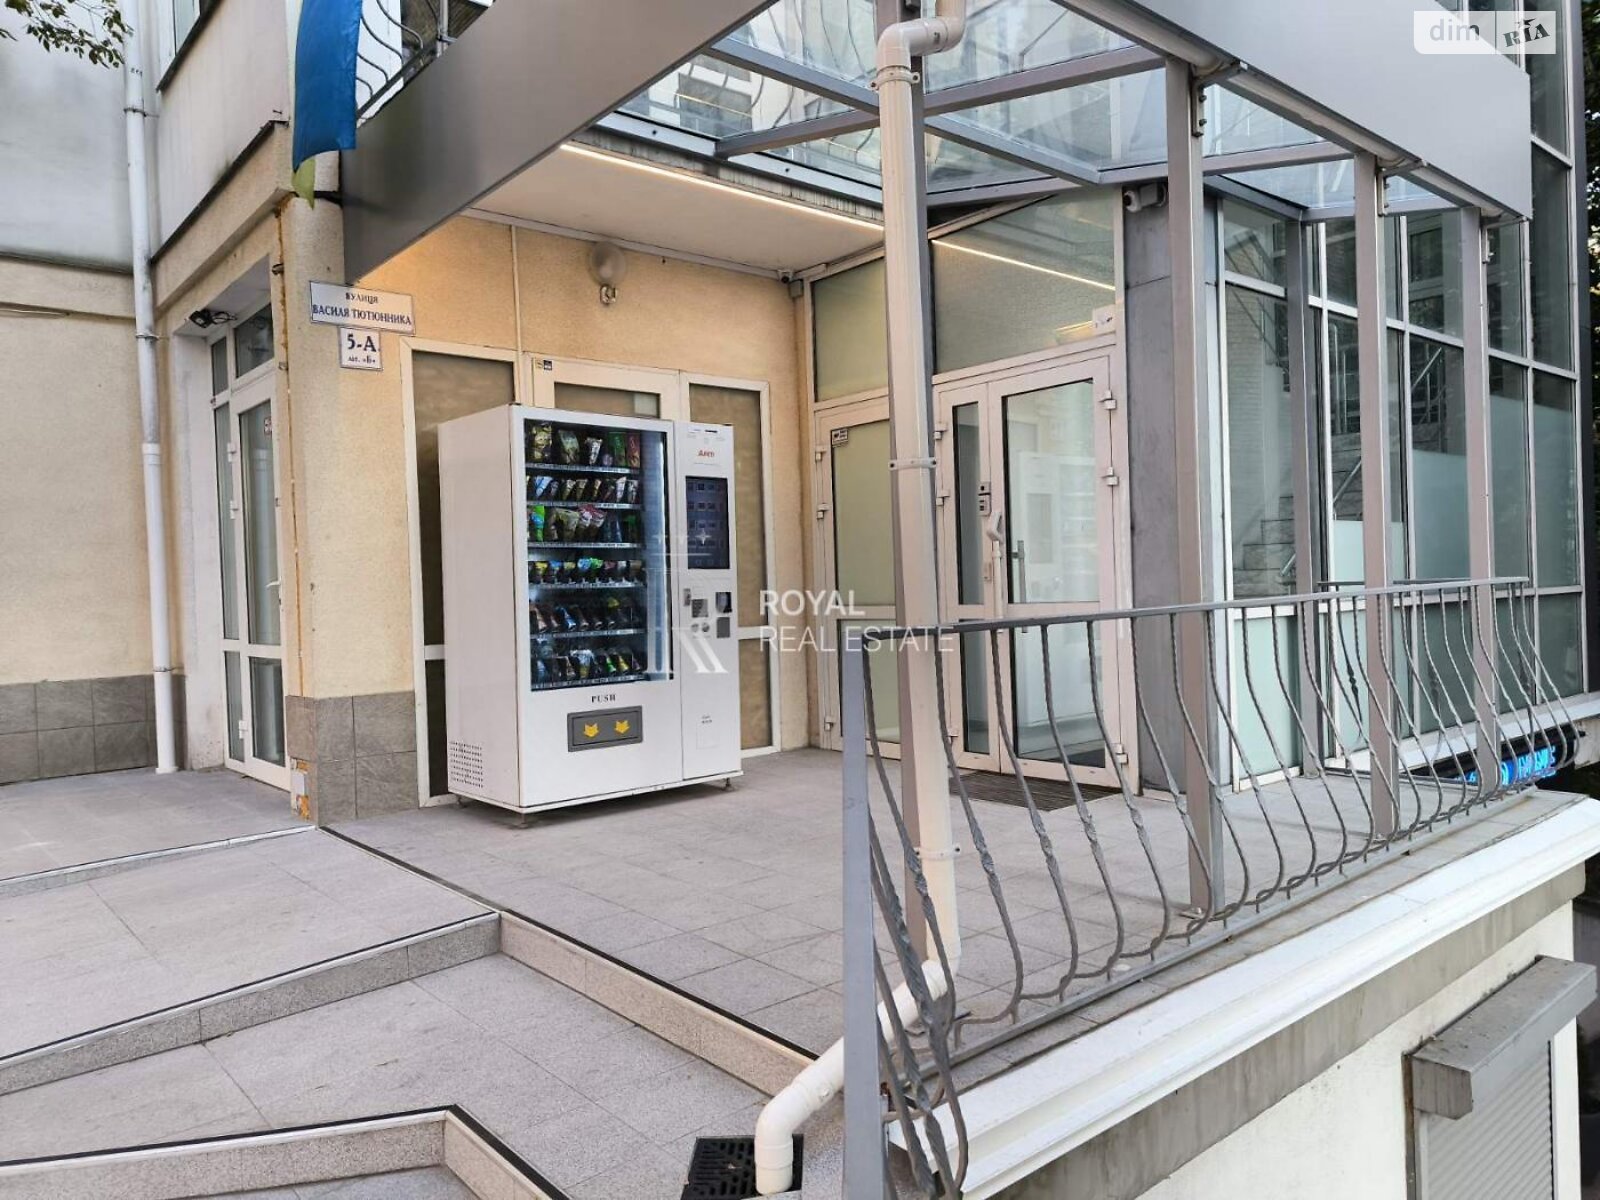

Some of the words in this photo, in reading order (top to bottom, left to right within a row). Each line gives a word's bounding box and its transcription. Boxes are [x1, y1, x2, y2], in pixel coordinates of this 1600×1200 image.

[345, 292, 379, 304] ВУЛИЦЯ
[312, 304, 350, 318] ВАСИЛЯ
[351, 309, 412, 325] ТЮТЮННИКА
[591, 694, 616, 703] PUSH
